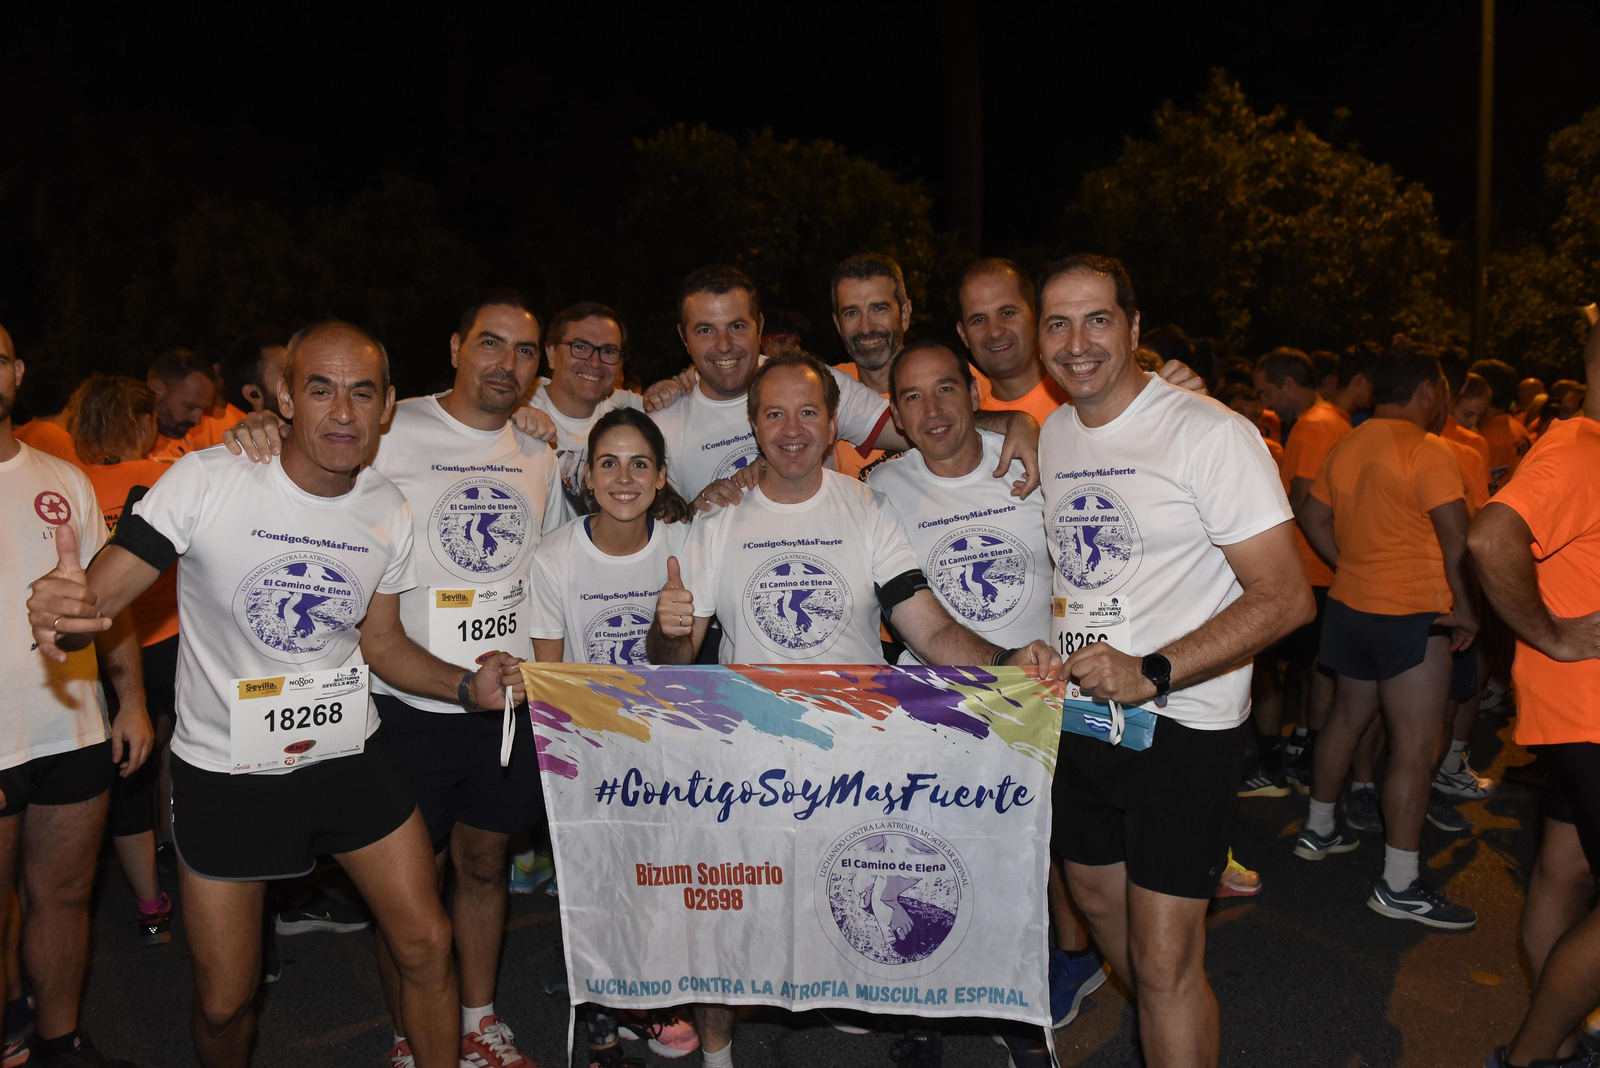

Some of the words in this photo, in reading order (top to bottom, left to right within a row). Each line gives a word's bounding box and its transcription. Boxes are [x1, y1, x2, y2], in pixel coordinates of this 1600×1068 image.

[702, 432, 755, 450] #ContigoSoyM
[431, 464, 523, 474] #ContigoSoyMásFuerte
[433, 491, 454, 518] LUCHANDO
[452, 481, 472, 493] CONTRA
[918, 505, 1016, 529] #ContigoSoyMásFuerte
[1122, 510, 1136, 536] ESPINAL
[250, 528, 370, 554] #ContigoSoyMásFuerte
[743, 538, 843, 549] #ContigoSoyMásFuerte
[940, 534, 958, 549] CONTRA
[988, 528, 1017, 545] MUSCULAR
[1016, 542, 1032, 560] ESPINAL
[948, 554, 978, 564] Camino
[990, 548, 1013, 556] Elena
[241, 564, 270, 592] LUCHANDO
[270, 554, 298, 568] CONTRA
[308, 554, 335, 566] ATROFIA
[335, 563, 358, 587] MUSCULAR
[746, 570, 764, 598] LUCHANDO
[762, 558, 781, 572] CONTRA
[812, 558, 838, 578] MUSCULAR
[768, 580, 798, 588] Camino
[274, 580, 312, 590] Camino
[313, 584, 326, 592] de
[328, 587, 352, 596] Elena
[441, 593, 468, 602] Sevilla
[580, 590, 660, 600] #ContigoSoyMásFuert
[458, 612, 516, 642] 18265
[246, 682, 276, 692] Sevilla
[264, 702, 343, 732] 18268
[594, 768, 1036, 823] #ContigoSoyMasFuerte
[820, 840, 846, 878] LUCHANDO
[844, 824, 874, 842] CONTRA
[886, 822, 920, 835] ATROFIA
[919, 830, 956, 857] MUSCULAR
[952, 856, 970, 888] ESPINAL
[842, 858, 852, 868] El
[854, 859, 896, 870] Camino
[898, 861, 912, 872] de
[916, 862, 946, 872] Elena
[636, 863, 692, 886] Bizum
[697, 862, 782, 886] Solidario
[683, 888, 744, 911] 02698
[586, 979, 672, 996] LUCHANDO
[678, 976, 745, 994] CONTRA
[751, 980, 774, 994] LA
[780, 981, 849, 1000] ATROFIA
[856, 984, 948, 1005] MUSCULAR
[955, 986, 1030, 1008] ESPINAL
